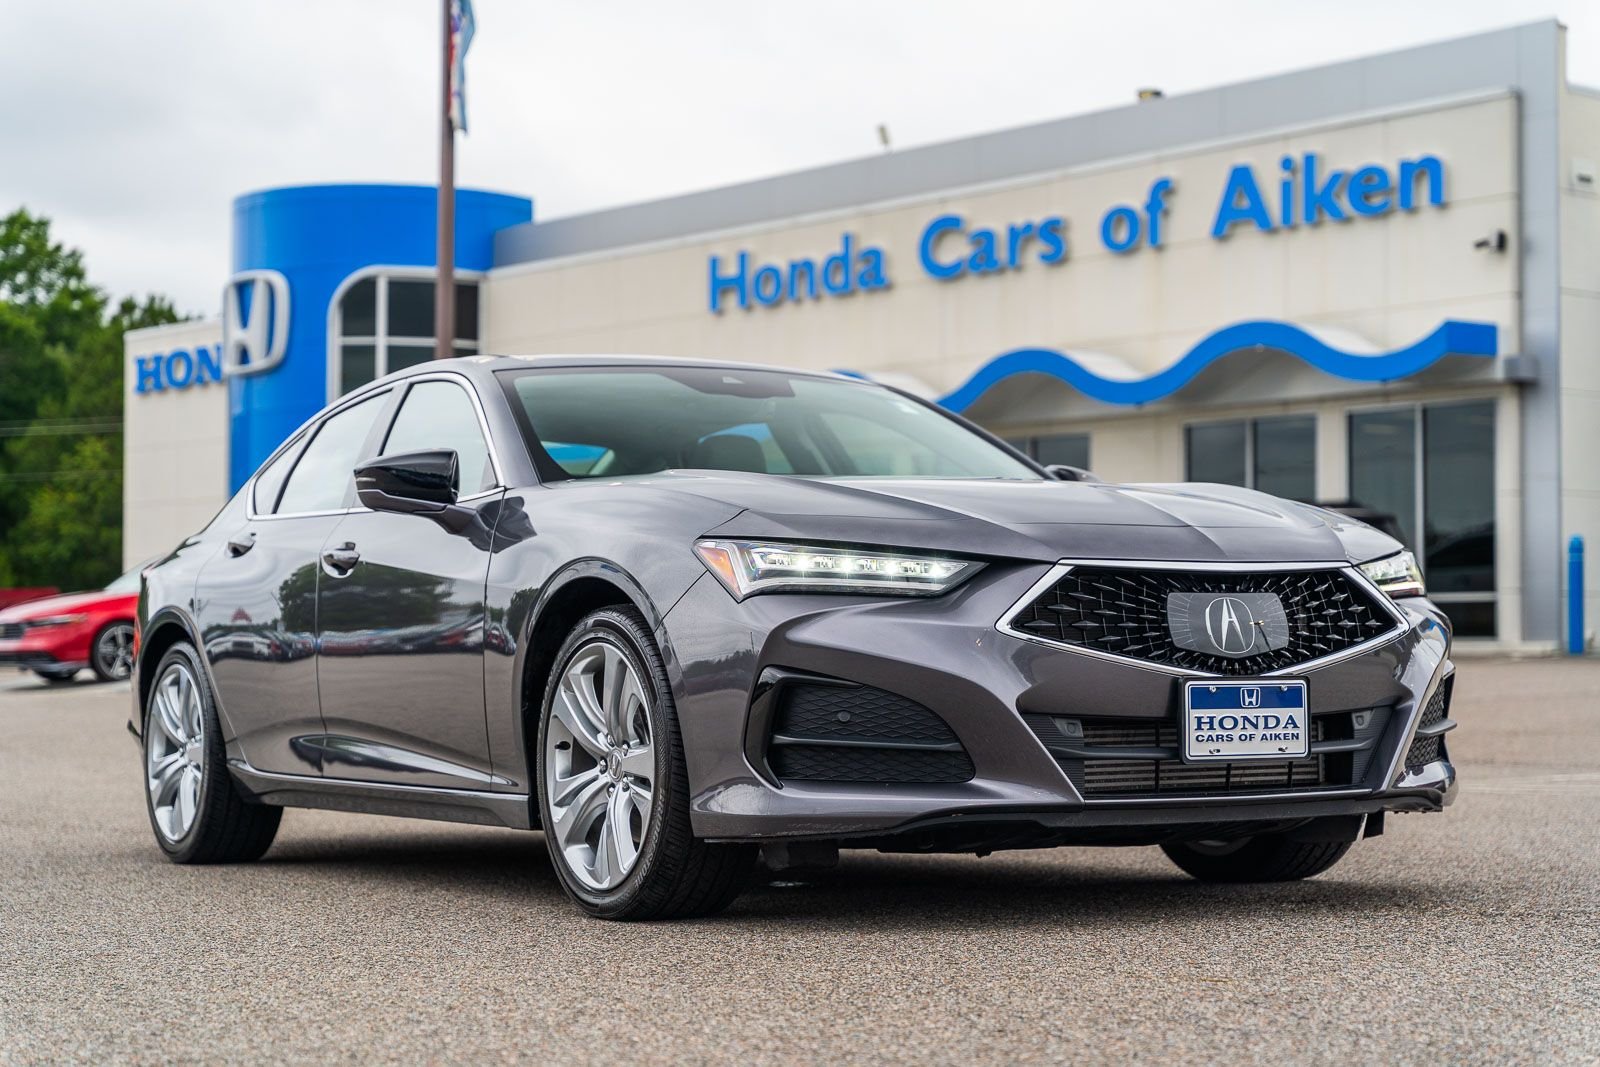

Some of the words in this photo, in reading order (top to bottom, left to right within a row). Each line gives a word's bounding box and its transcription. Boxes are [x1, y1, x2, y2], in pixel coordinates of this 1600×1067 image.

[709, 235, 890, 312] Honda
[920, 215, 1065, 279] Cars
[1101, 178, 1174, 253] of
[1212, 153, 1445, 238] Aiken
[1195, 715, 1300, 730] HONDA
[1195, 734, 1234, 742] CARS
[1238, 733, 1256, 741] OF
[1260, 732, 1299, 741] AIKEN
